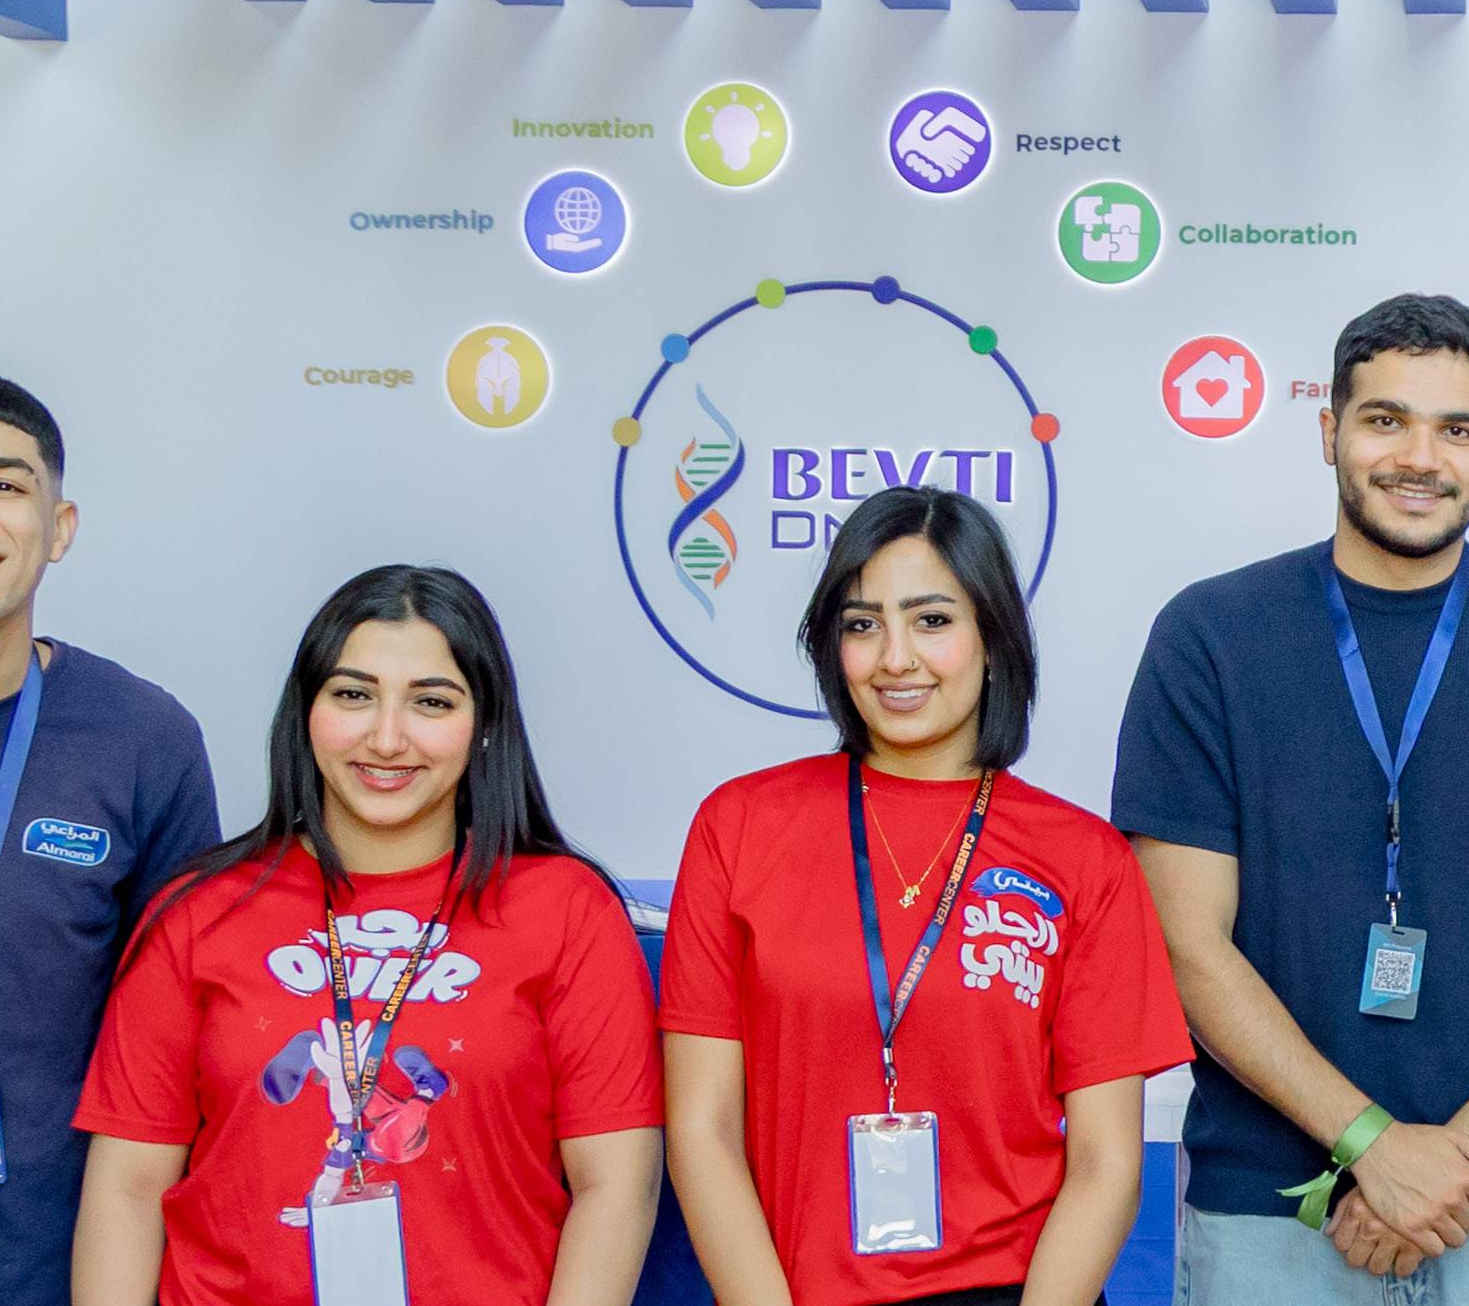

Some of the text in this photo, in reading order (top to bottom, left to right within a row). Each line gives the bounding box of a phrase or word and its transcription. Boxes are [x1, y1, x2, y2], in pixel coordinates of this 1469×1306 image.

[512, 117, 655, 141] Innovation
[1016, 132, 1122, 156] Respect
[350, 209, 494, 235] Ownership
[1179, 223, 1358, 247] Collaboration
[304, 365, 414, 388] Courage
[934, 832, 976, 927] CAREERCENTER
[266, 944, 482, 1003] OVER
